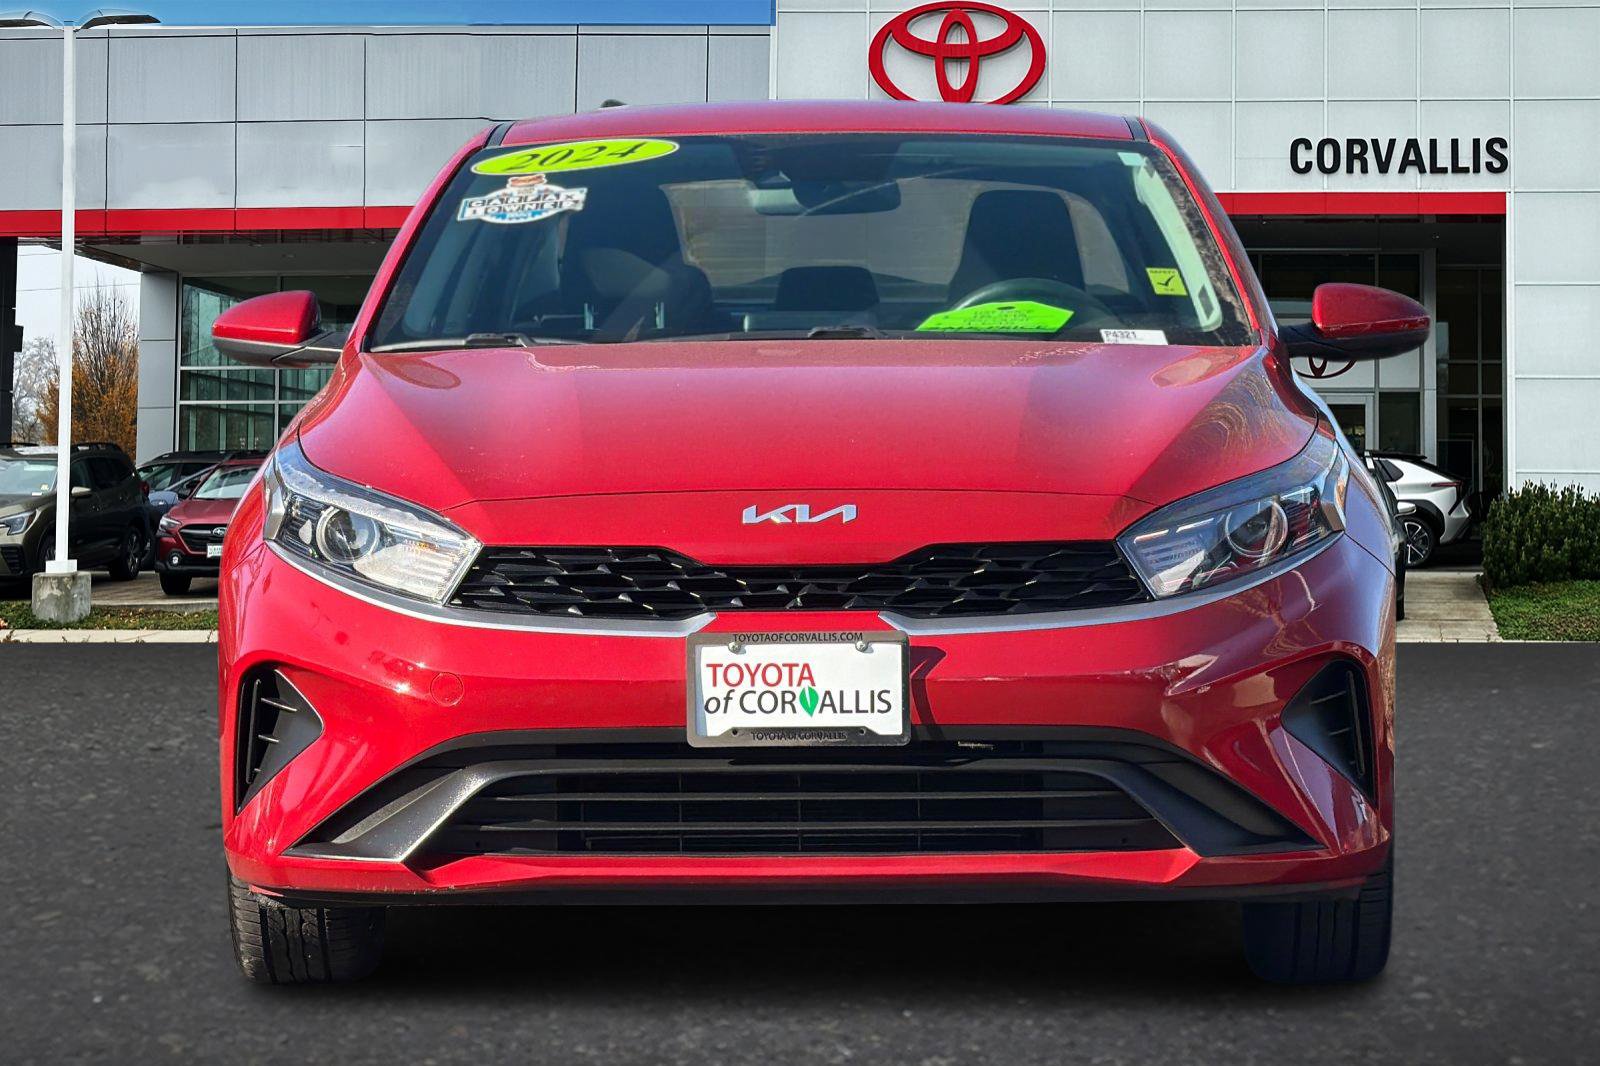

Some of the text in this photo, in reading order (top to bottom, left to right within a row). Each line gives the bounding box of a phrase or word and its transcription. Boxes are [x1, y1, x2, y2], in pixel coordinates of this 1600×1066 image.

[501, 142, 647, 171] 2024
[1290, 137, 1509, 174] CORVALLIS
[733, 632, 863, 643] TOYOTAOFCORVALLIS.COM
[705, 662, 816, 687] TOYOTA
[704, 688, 735, 714] of
[751, 731, 786, 740] TOYOTA
